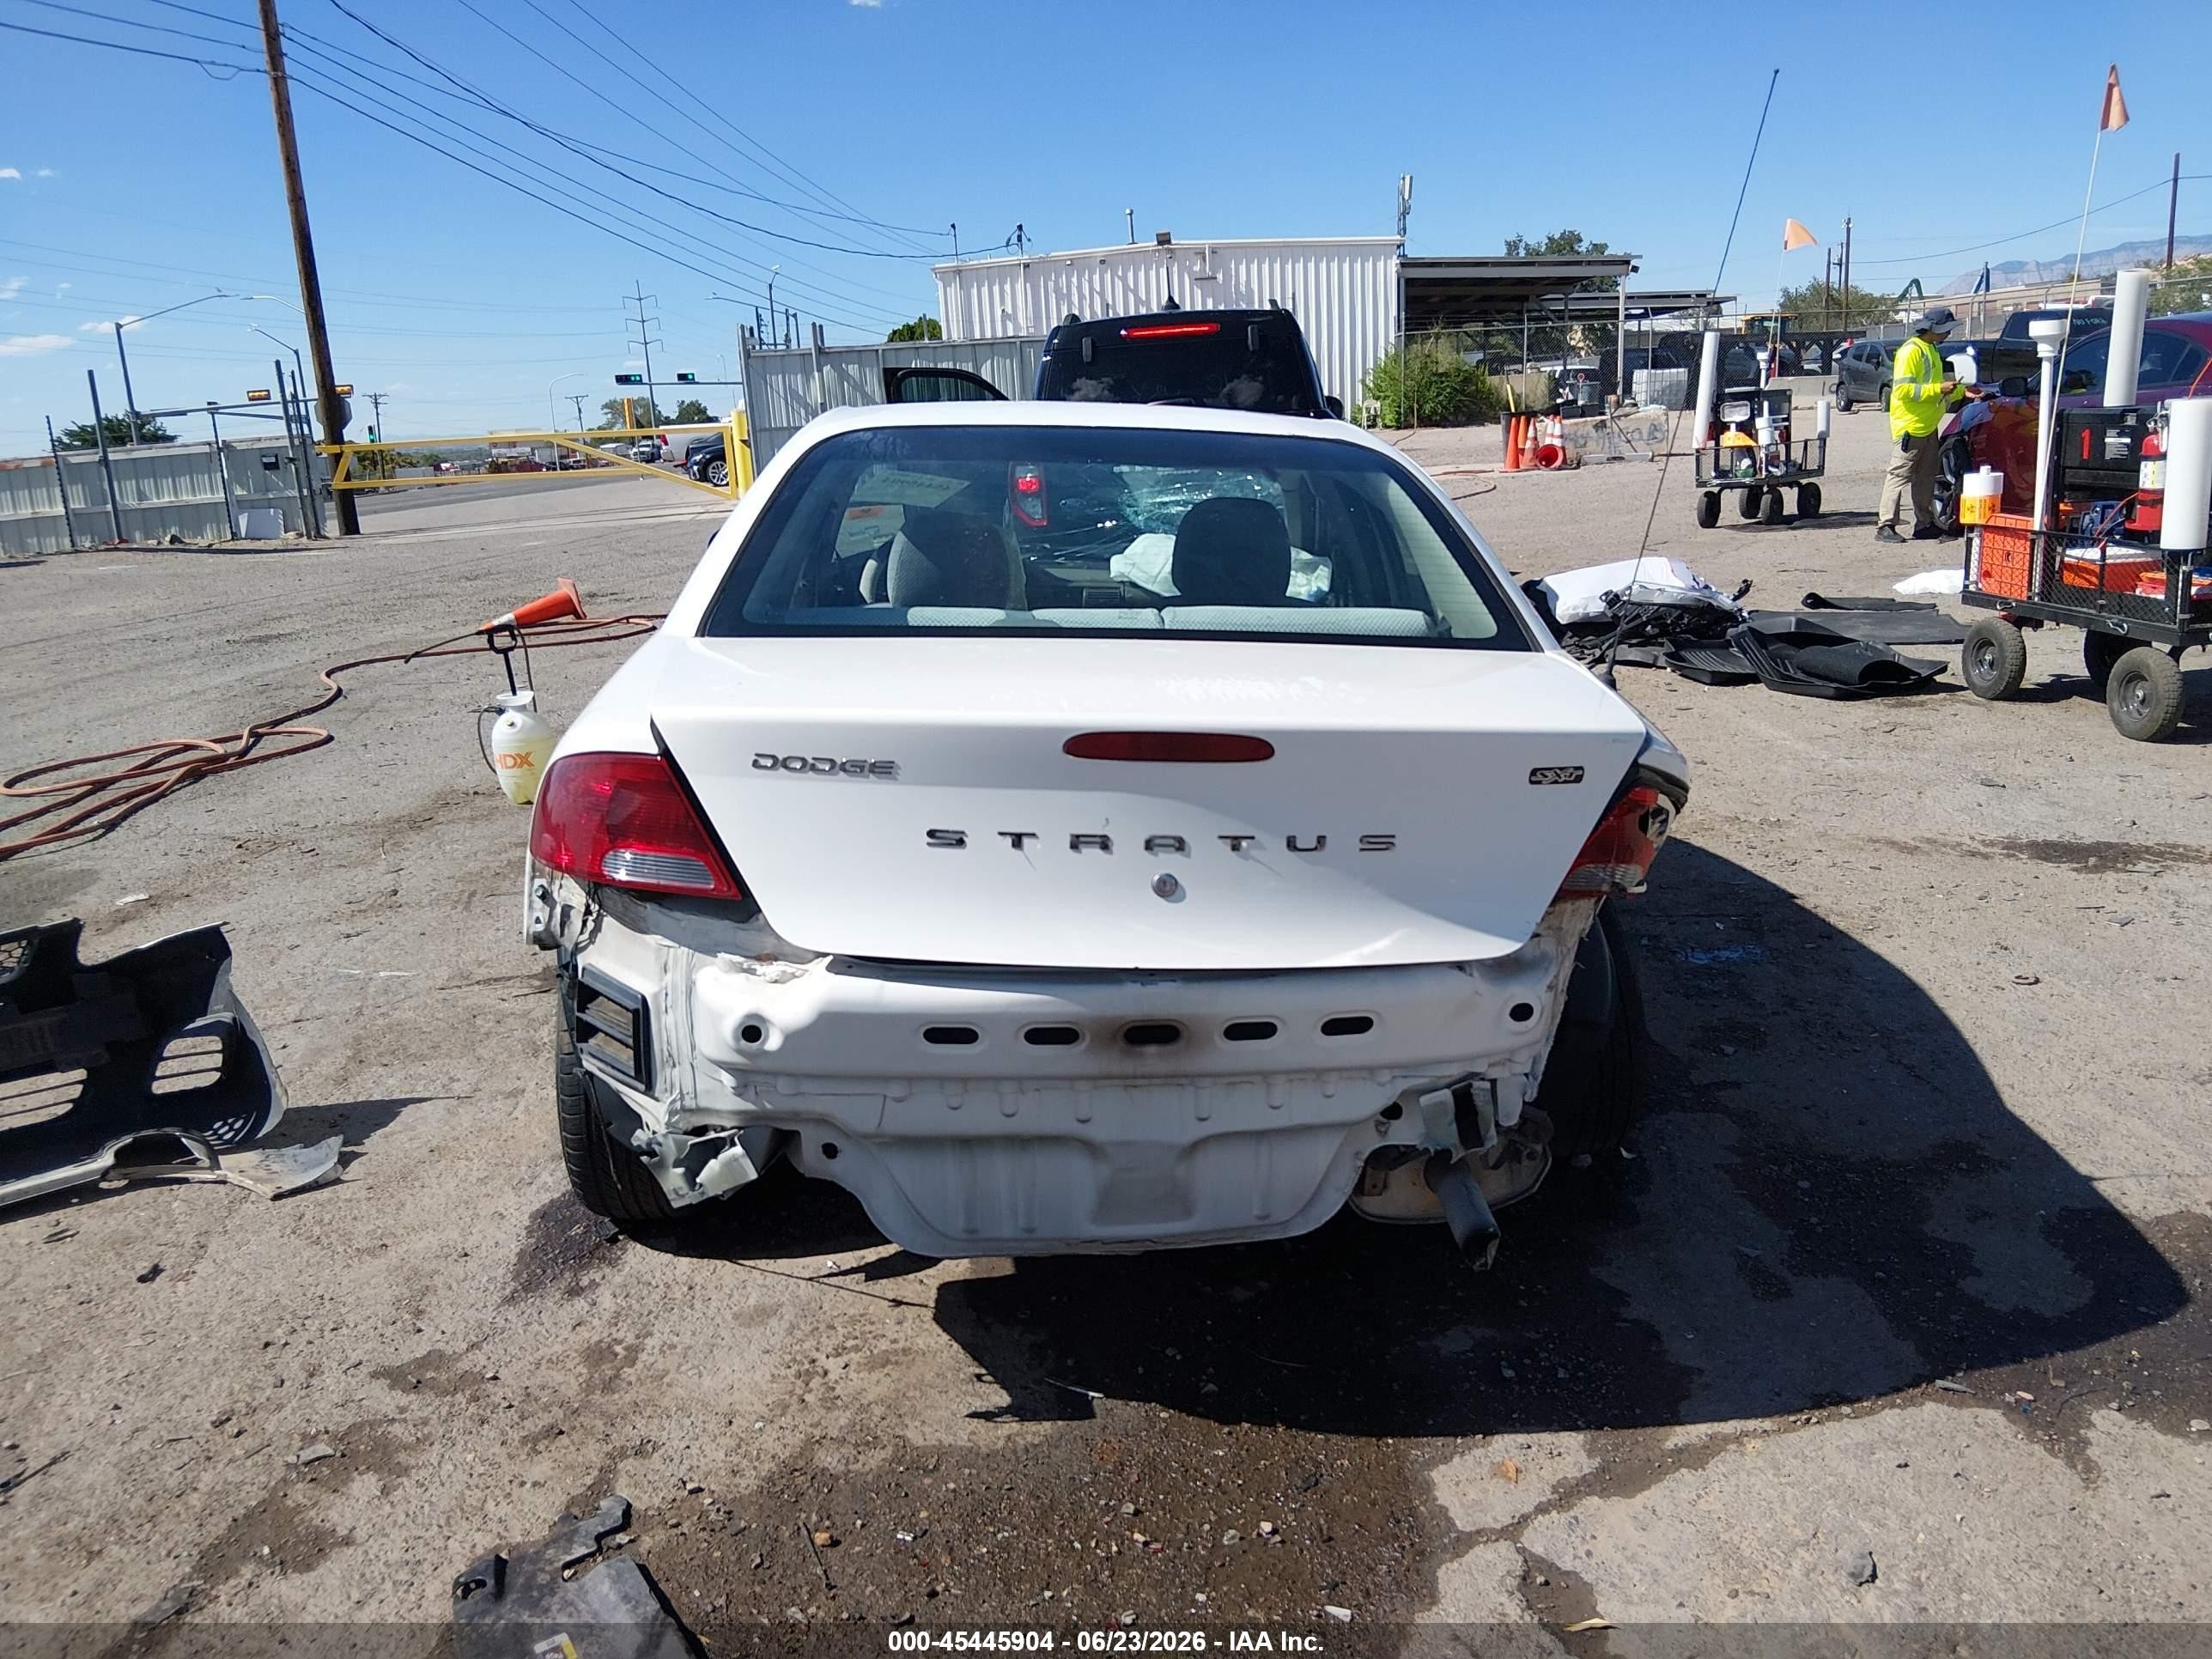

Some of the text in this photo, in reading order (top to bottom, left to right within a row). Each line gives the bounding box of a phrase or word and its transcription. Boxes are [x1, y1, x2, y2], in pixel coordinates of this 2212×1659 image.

[2081, 428, 2093, 460] 1
[494, 750, 535, 770] HDX
[751, 752, 896, 776] DODGE
[1530, 767, 1583, 785] SXT
[926, 828, 1397, 854] STRATUS
